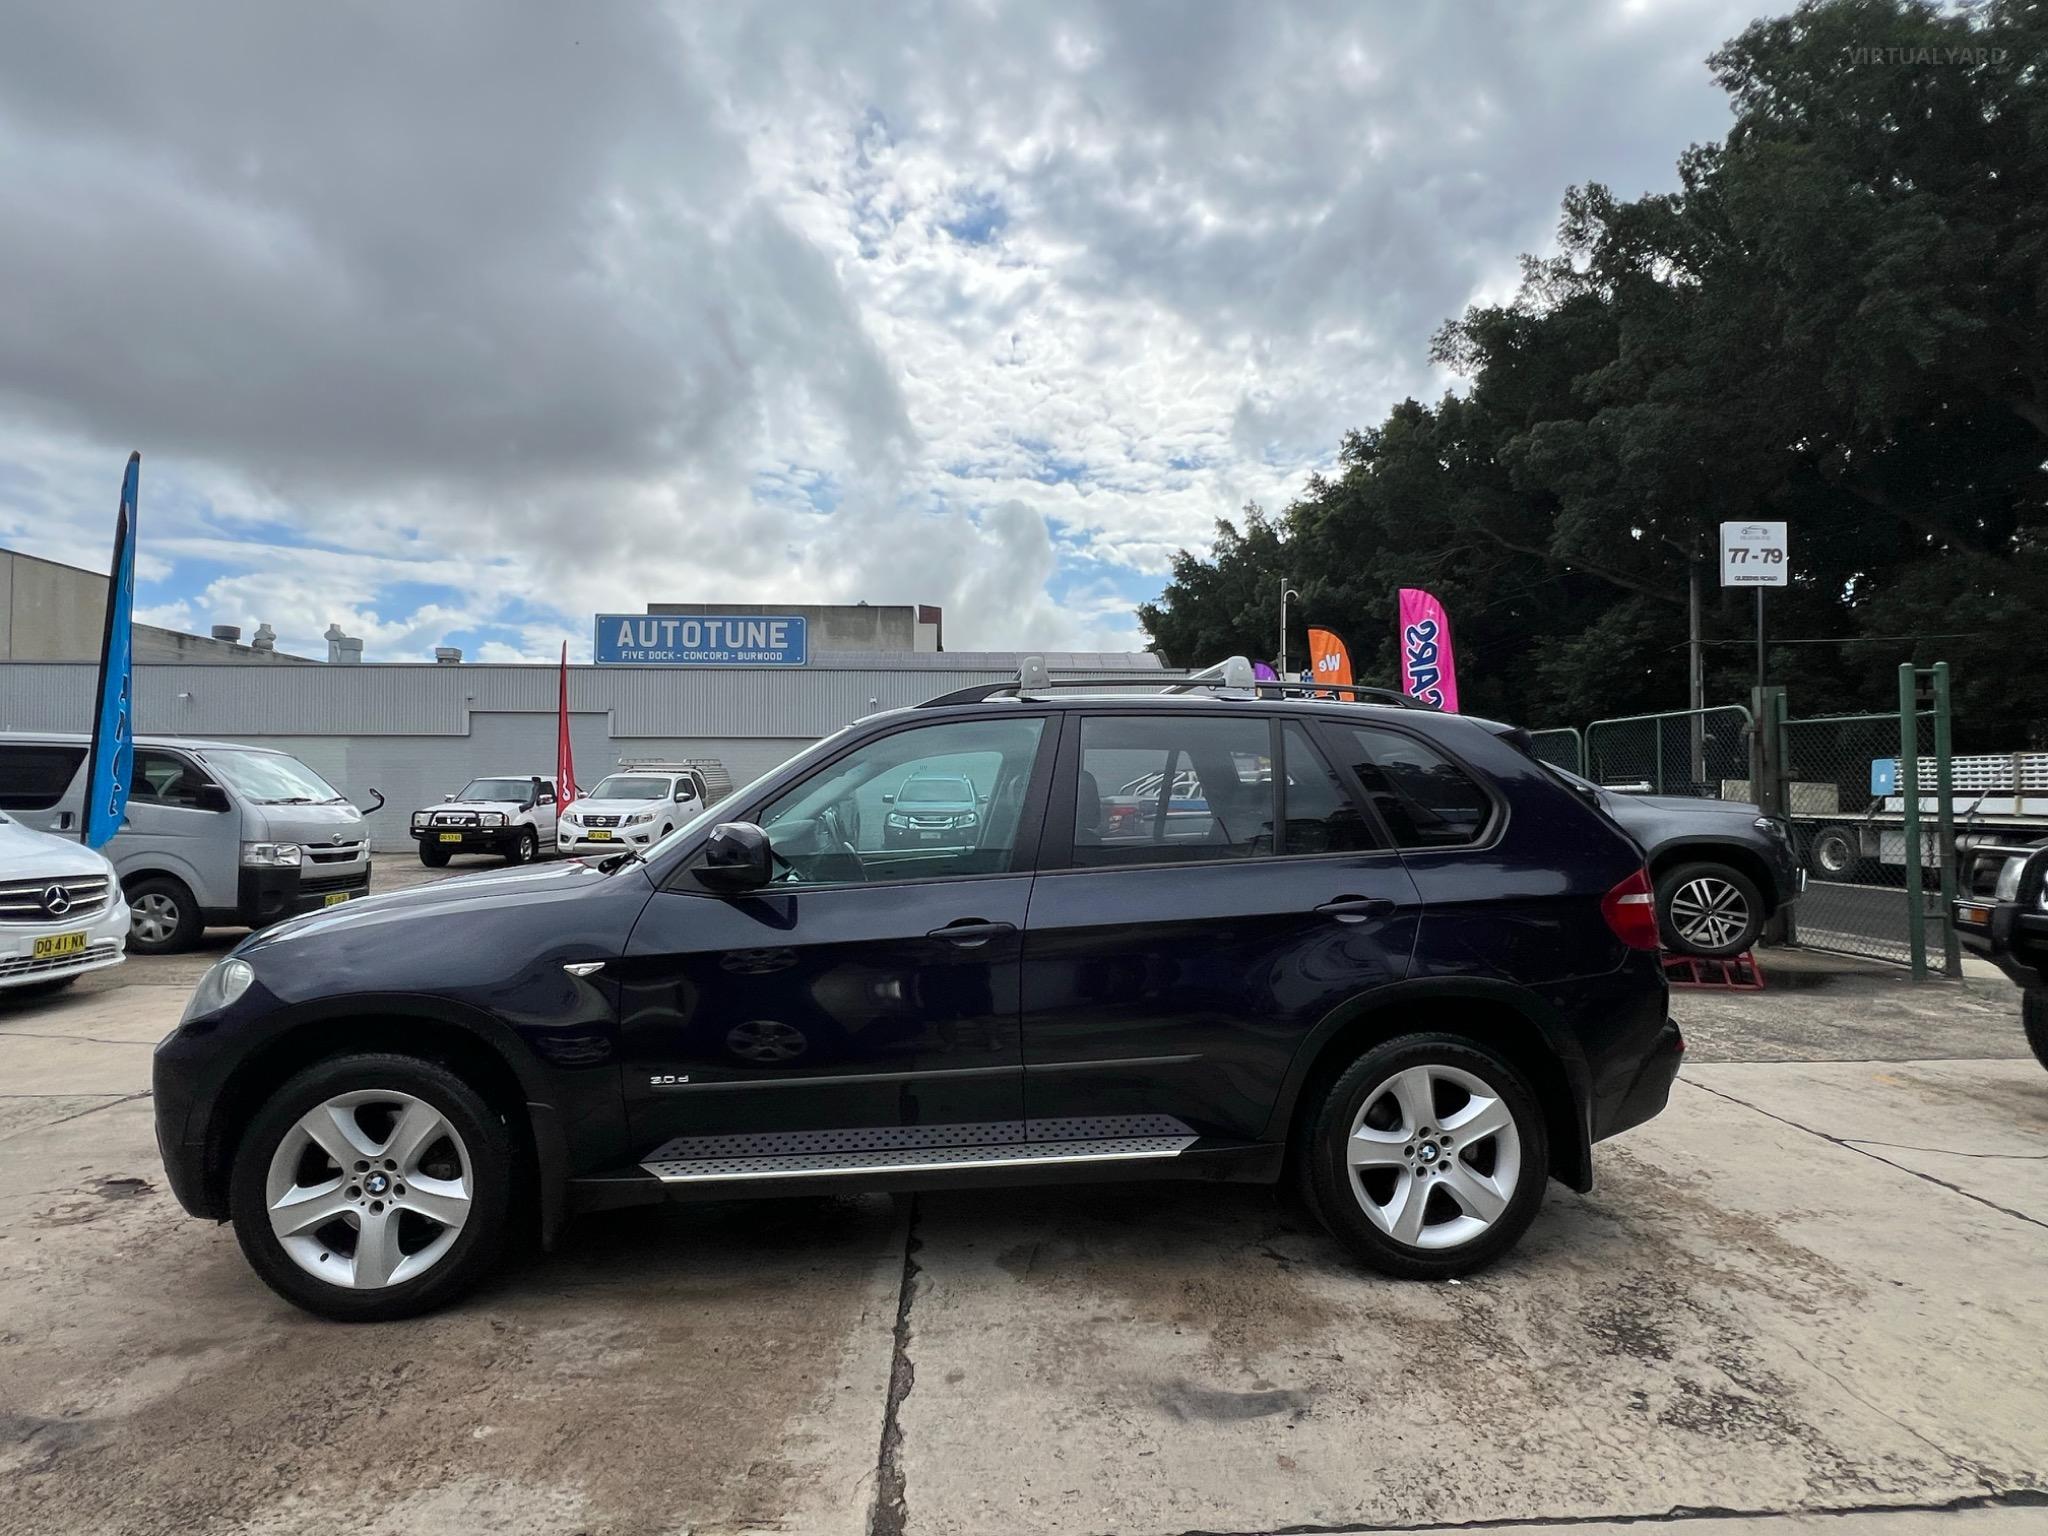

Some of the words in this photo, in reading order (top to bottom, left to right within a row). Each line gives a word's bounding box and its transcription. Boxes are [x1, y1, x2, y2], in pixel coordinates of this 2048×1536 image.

[617, 620, 789, 648] AUTOTUNE
[622, 651, 645, 660] FIVE
[648, 651, 674, 660] DOCK
[683, 651, 729, 661] CONCORD
[737, 652, 783, 661] BURWOOD
